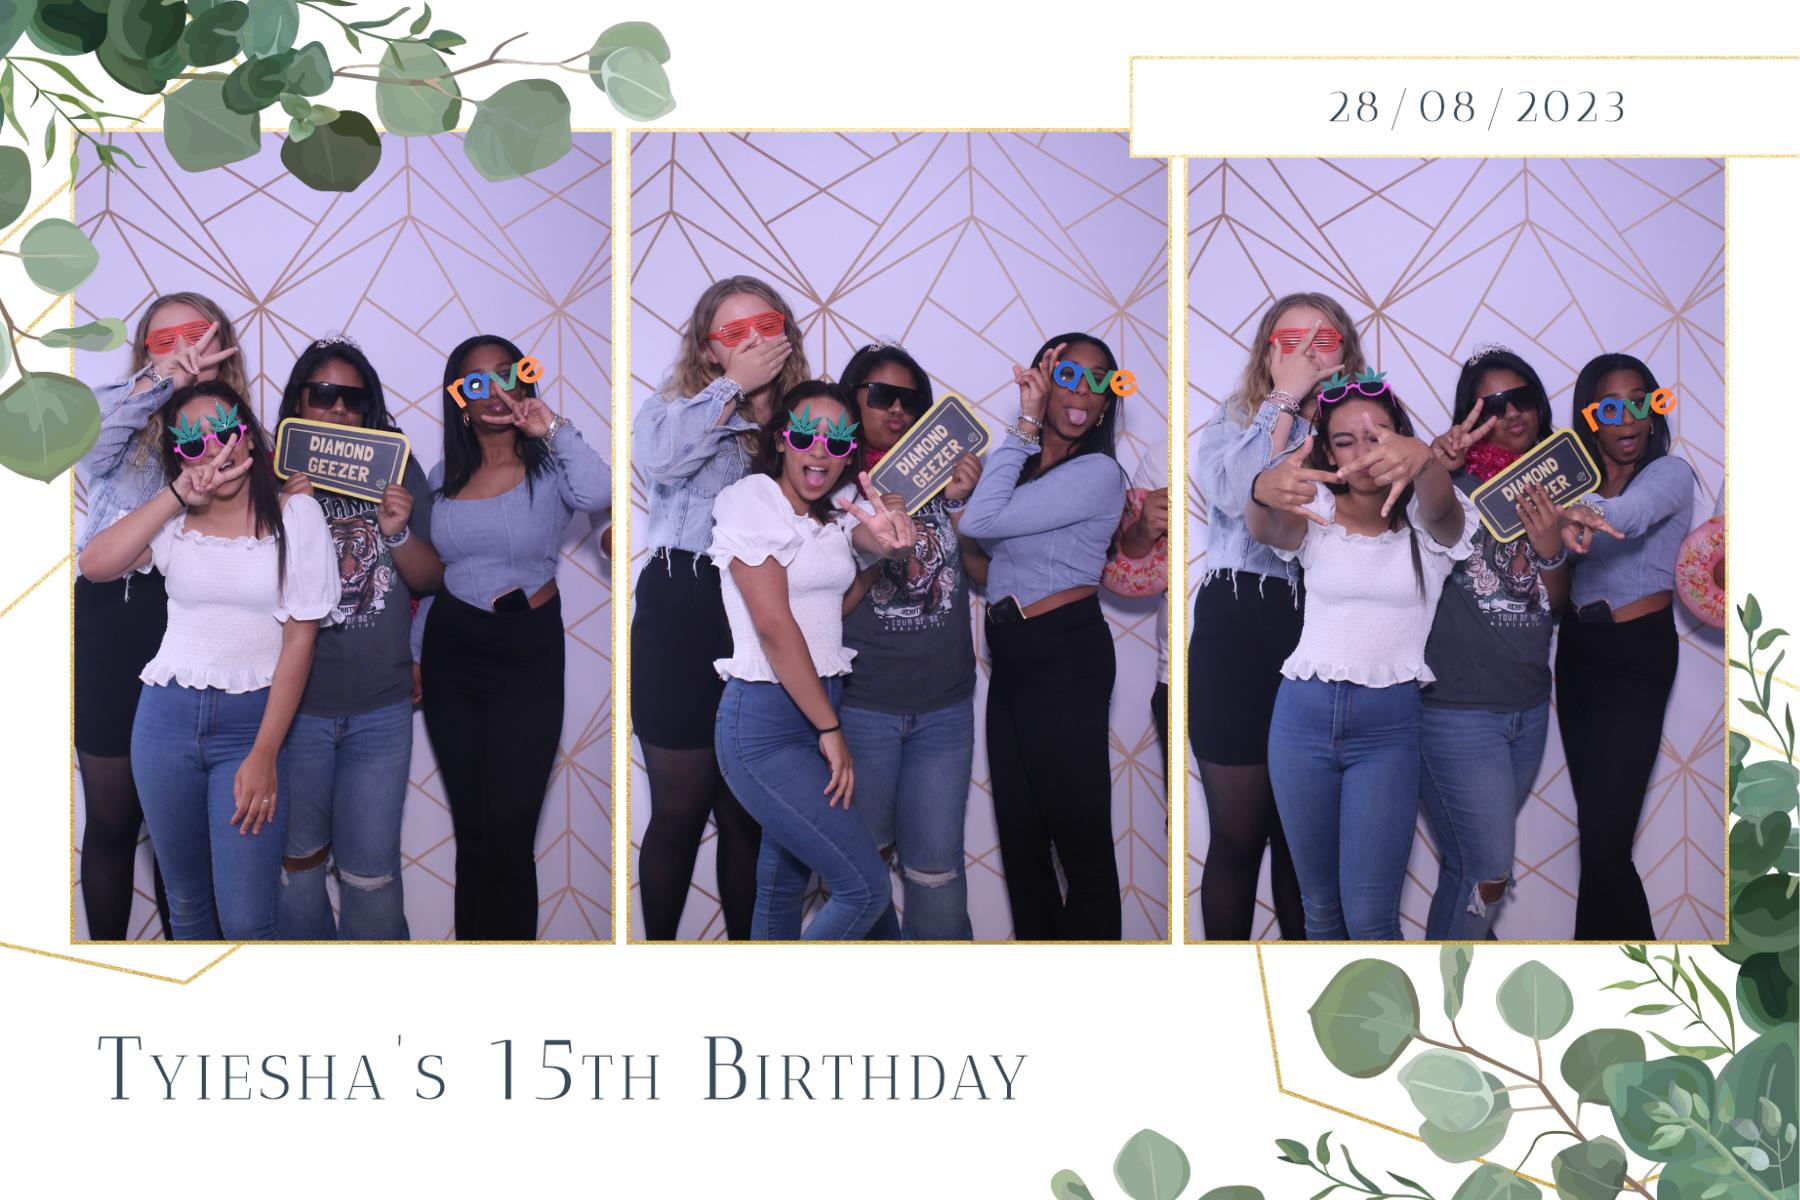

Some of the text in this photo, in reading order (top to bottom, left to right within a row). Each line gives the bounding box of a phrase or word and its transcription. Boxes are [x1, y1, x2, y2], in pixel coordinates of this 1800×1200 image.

[447, 356, 544, 408] rave
[1040, 361, 1137, 397] ave
[1581, 388, 1677, 432] rave
[308, 457, 370, 483] GEEZER
[309, 435, 375, 462] DIAMOND
[895, 424, 949, 476] DIAMOND
[912, 439, 964, 489] GEEZER
[1501, 457, 1559, 502] DIAMOND
